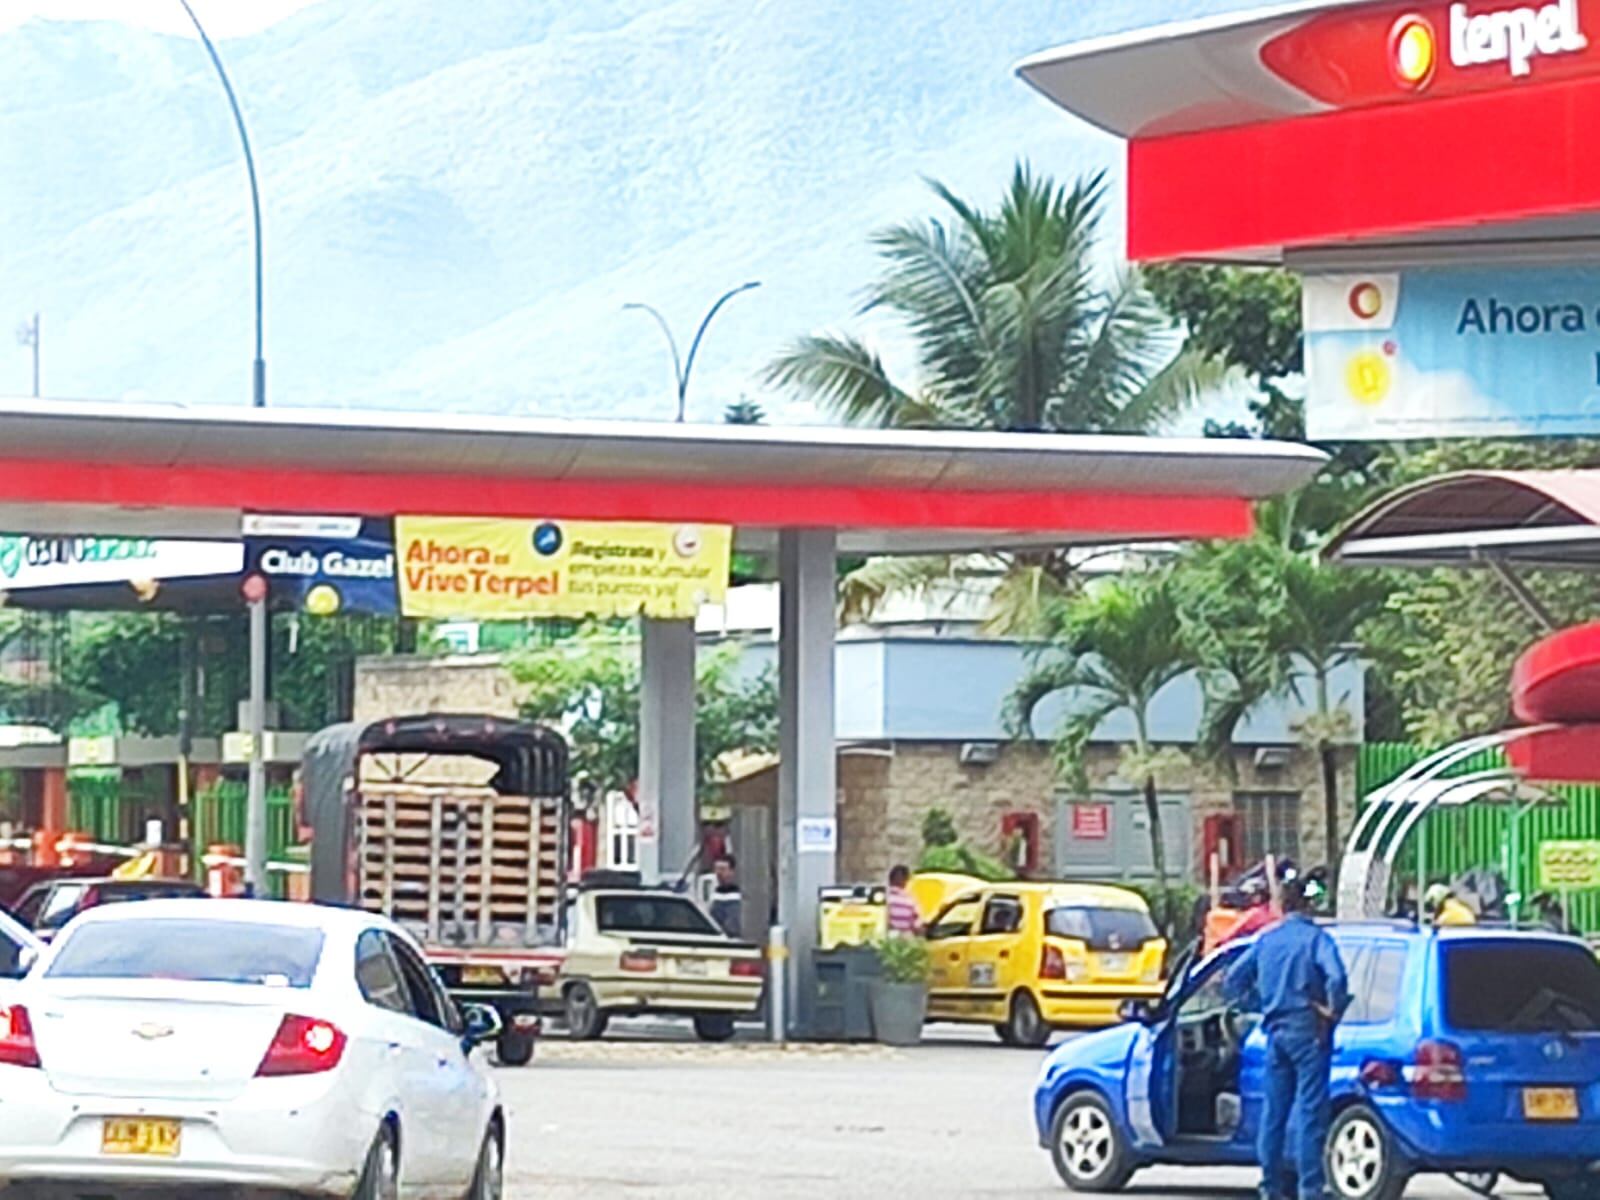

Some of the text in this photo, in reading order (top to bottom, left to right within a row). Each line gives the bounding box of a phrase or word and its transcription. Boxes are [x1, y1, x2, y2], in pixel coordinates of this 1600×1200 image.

[1450, 0, 1588, 77] terpel
[1457, 298, 1586, 334] Ahora
[261, 550, 395, 578] Club Gazel
[406, 539, 490, 564] Ahora
